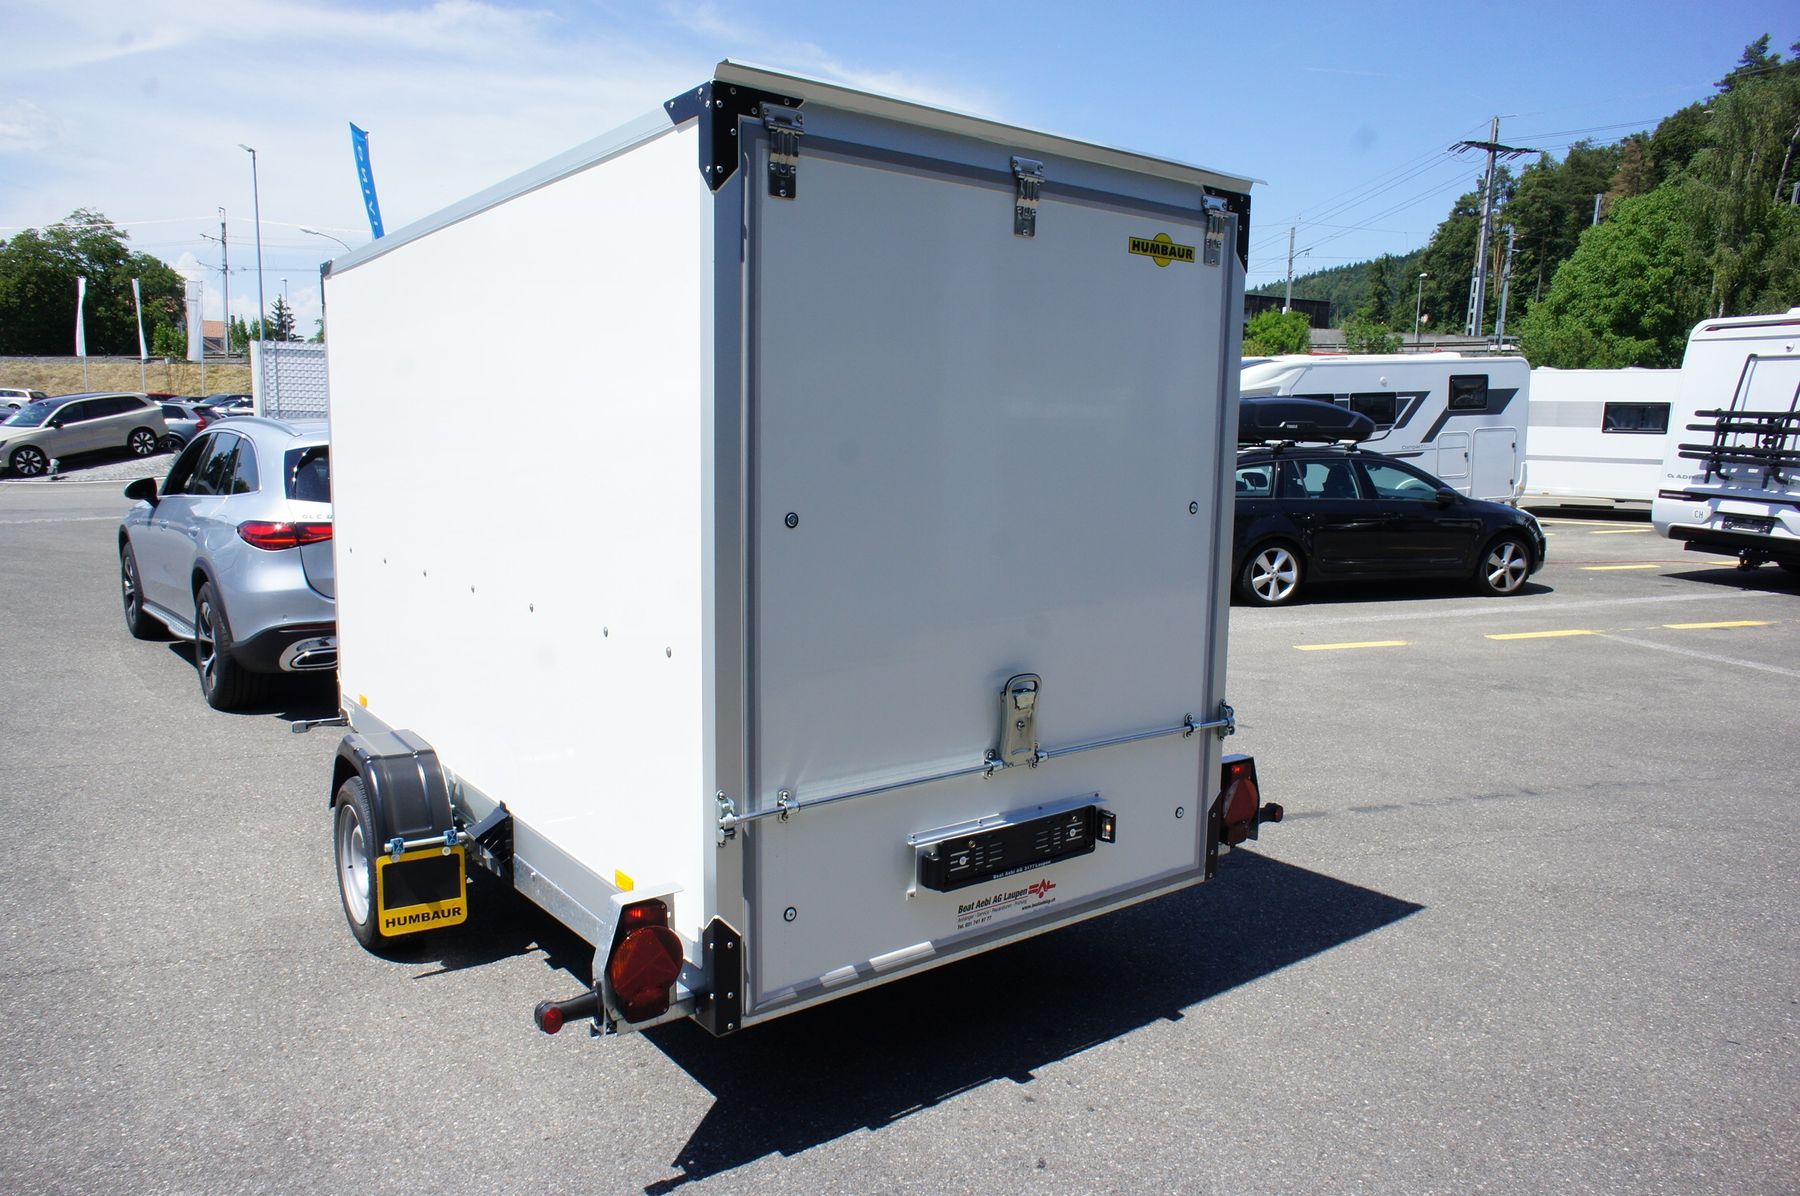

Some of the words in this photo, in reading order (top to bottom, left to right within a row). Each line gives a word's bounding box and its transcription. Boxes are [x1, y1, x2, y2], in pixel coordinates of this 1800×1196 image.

[1131, 240, 1193, 260] HUMBAUR
[1694, 511, 1704, 519] CH
[957, 902, 975, 914] Beat
[975, 896, 992, 909] Aebi
[992, 893, 1002, 904] AG
[1003, 888, 1028, 900] Laupen
[385, 906, 462, 929] HUMBAUR
